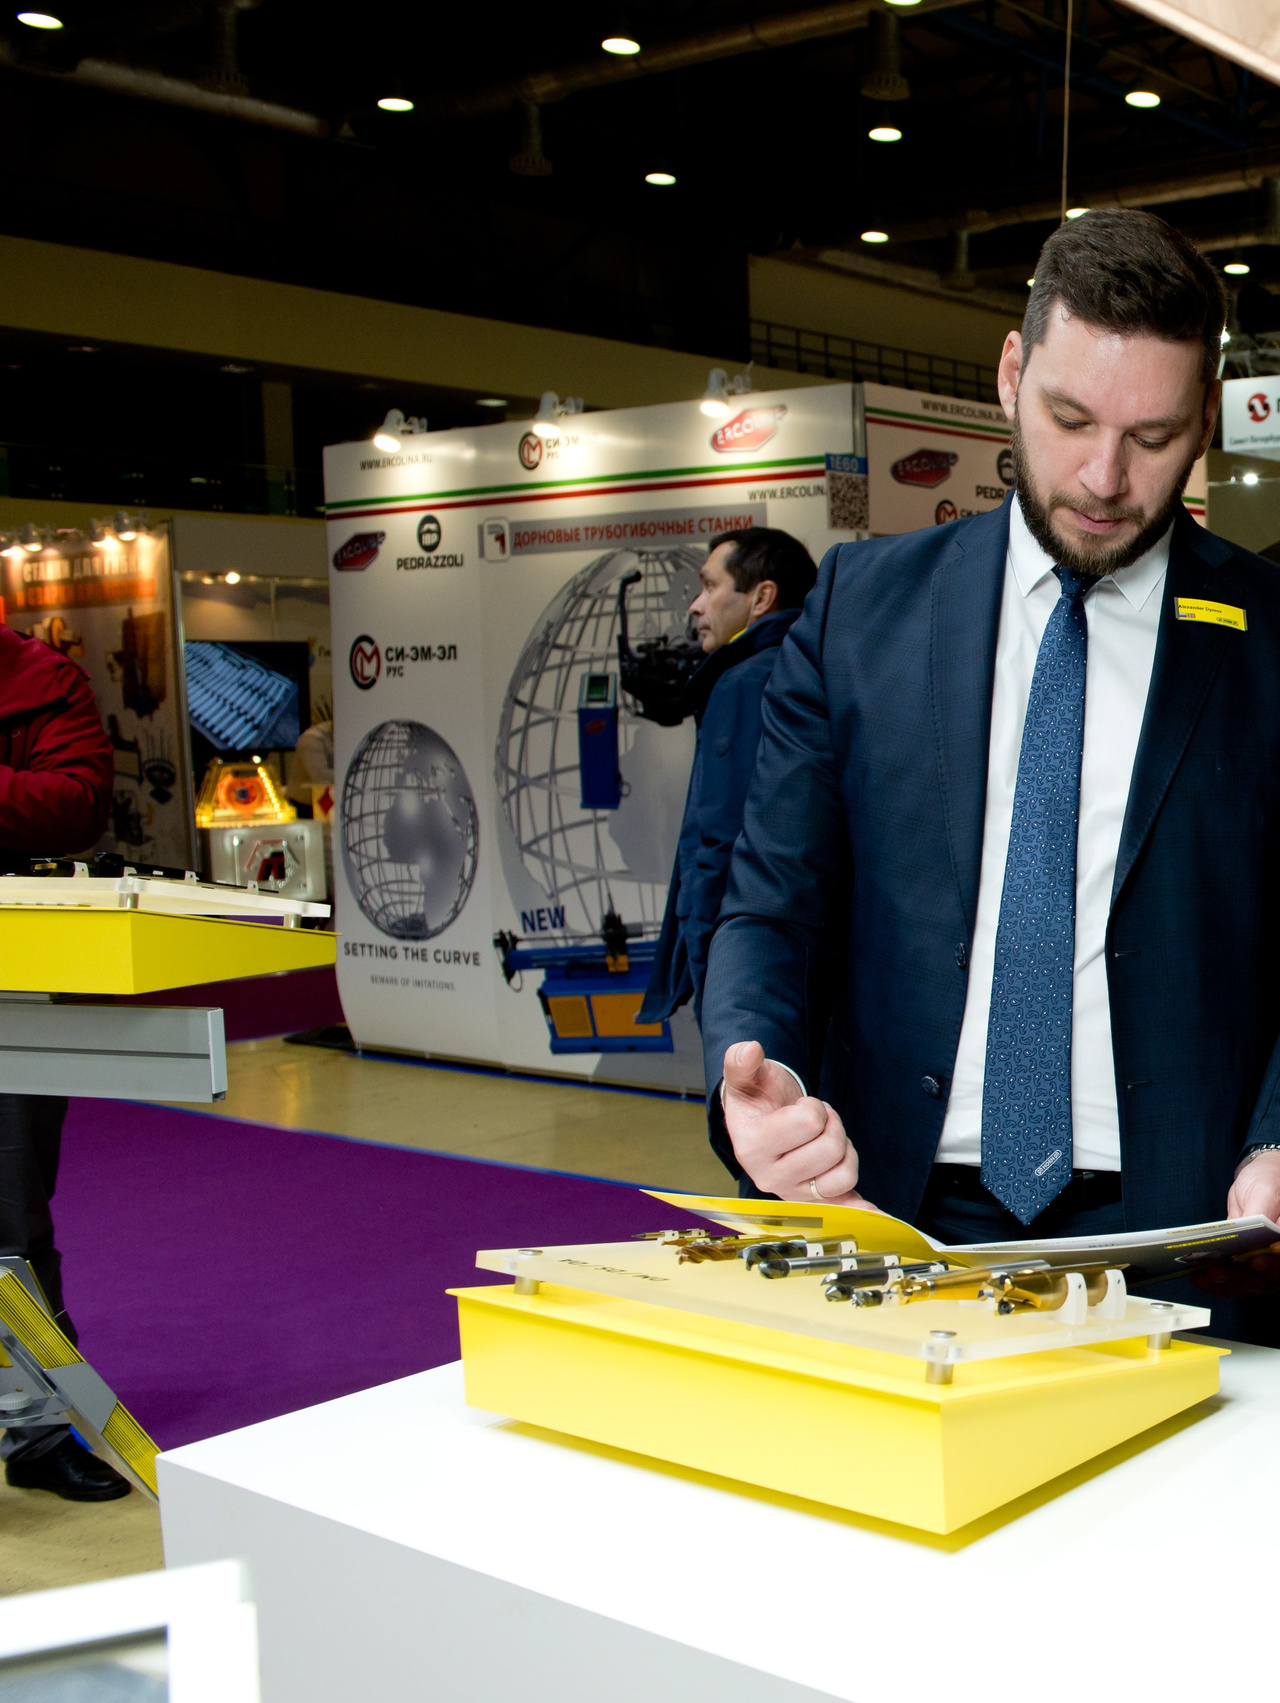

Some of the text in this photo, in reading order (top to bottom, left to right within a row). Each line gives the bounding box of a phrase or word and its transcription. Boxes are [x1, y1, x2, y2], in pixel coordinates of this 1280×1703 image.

[359, 453, 433, 471] WWW.ERCOLINA.RU
[513, 514, 754, 549] ДОРНОВЫЕ ТРУБОГИБОЧНЫЕ СТАНКИ
[396, 554, 464, 570] PEDRAZZOLI
[385, 644, 457, 662] СИ-ЭМ-ЭЛ
[386, 666, 404, 677] РУС
[521, 905, 566, 934] NEW
[343, 941, 481, 967] SETTING THE CURVE
[370, 974, 455, 991] BEWARE OF IMITATIONS
